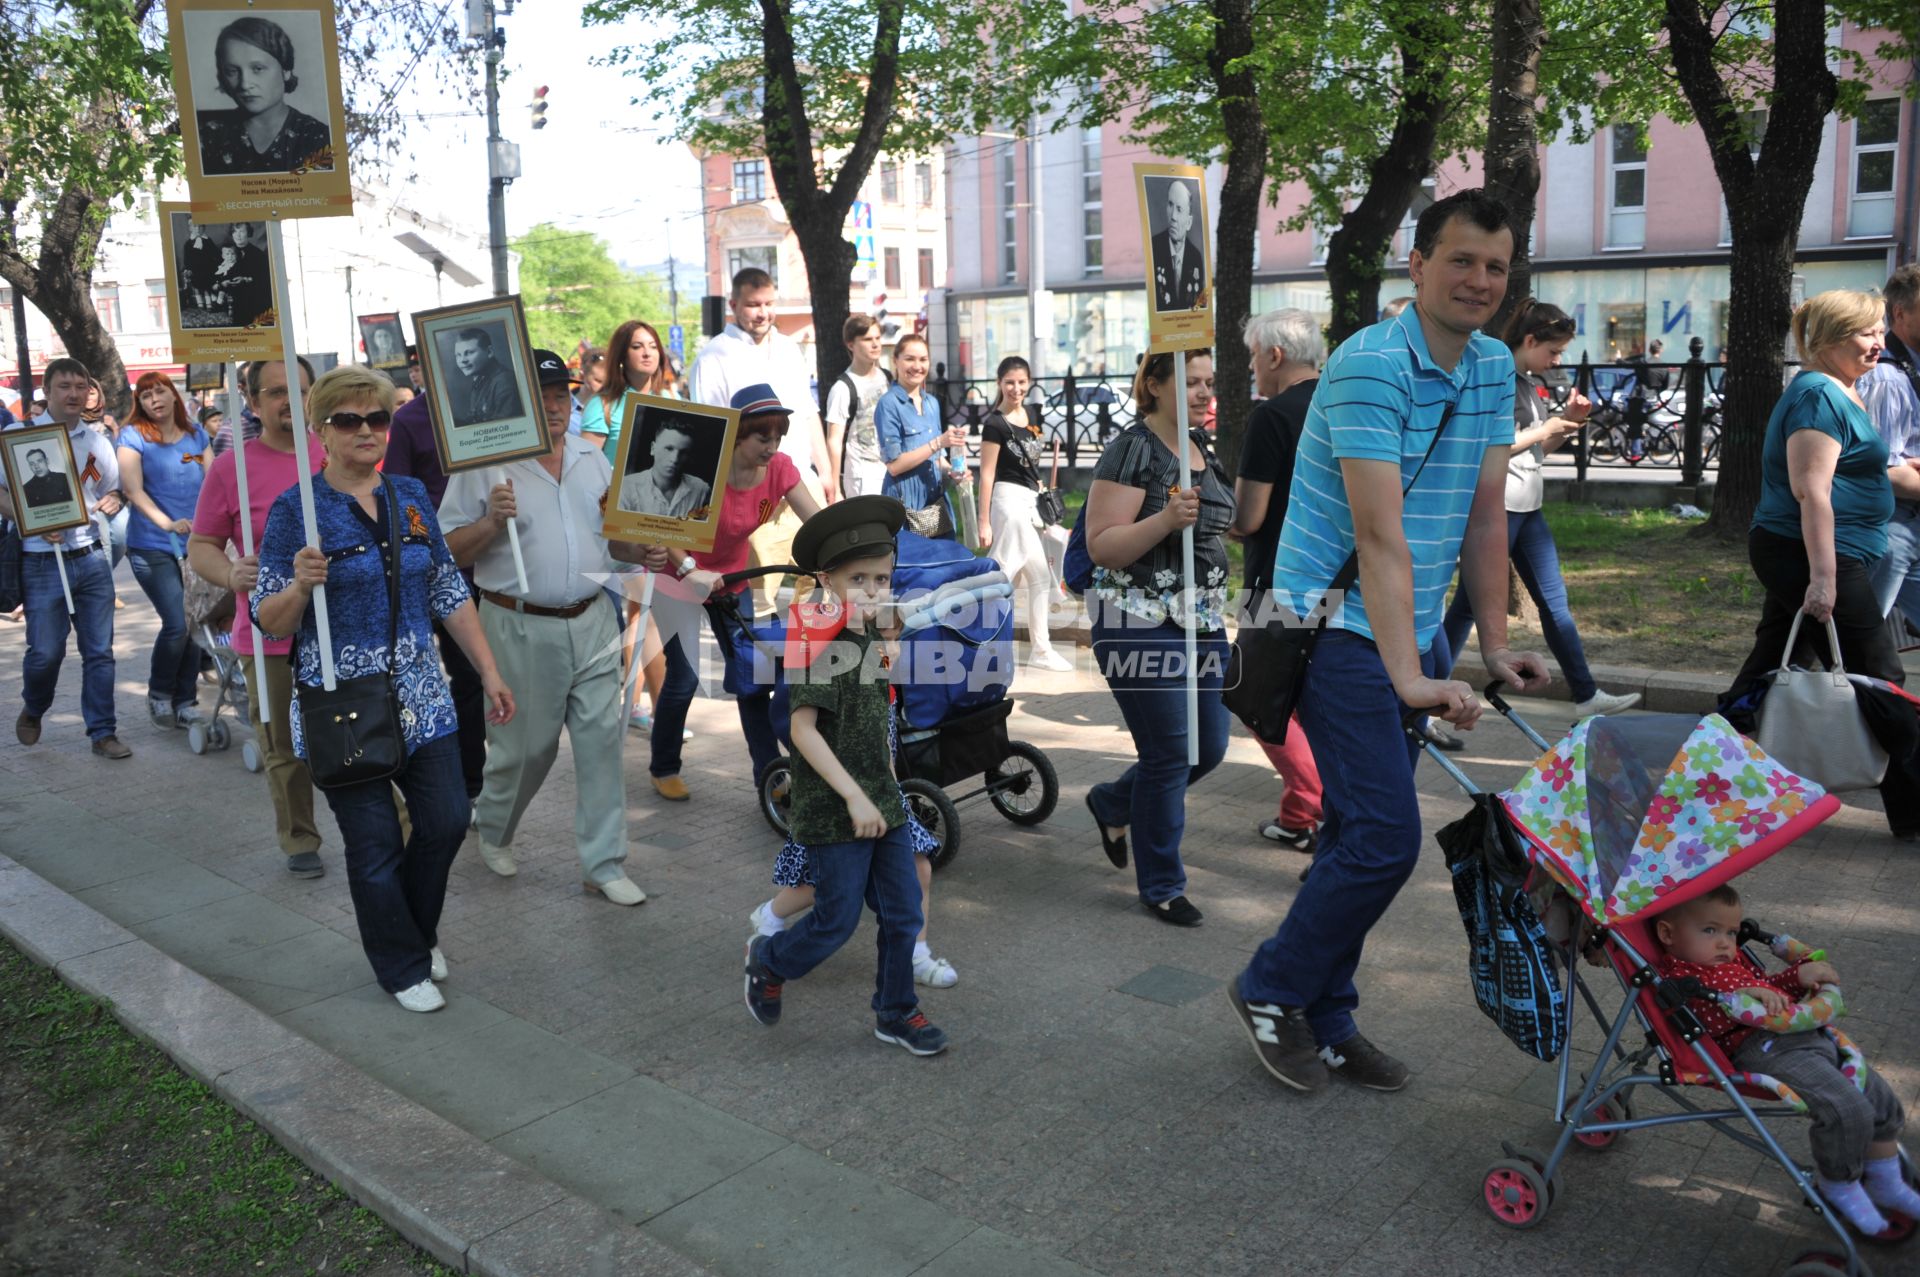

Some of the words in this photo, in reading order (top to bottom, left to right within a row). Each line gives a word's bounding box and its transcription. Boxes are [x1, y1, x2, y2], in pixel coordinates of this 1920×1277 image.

[241, 178, 267, 186] Носова
[268, 177, 301, 186] (Морева)
[241, 188, 259, 196] Нина
[260, 187, 303, 196] Михайловна
[226, 199, 293, 210] БЕССМЕРТНЫЙ
[293, 198, 321, 207] ПОЛК
[473, 424, 510, 437] НОВИКОВ
[459, 437, 481, 447] Борис
[482, 429, 527, 443] Дмитриевич
